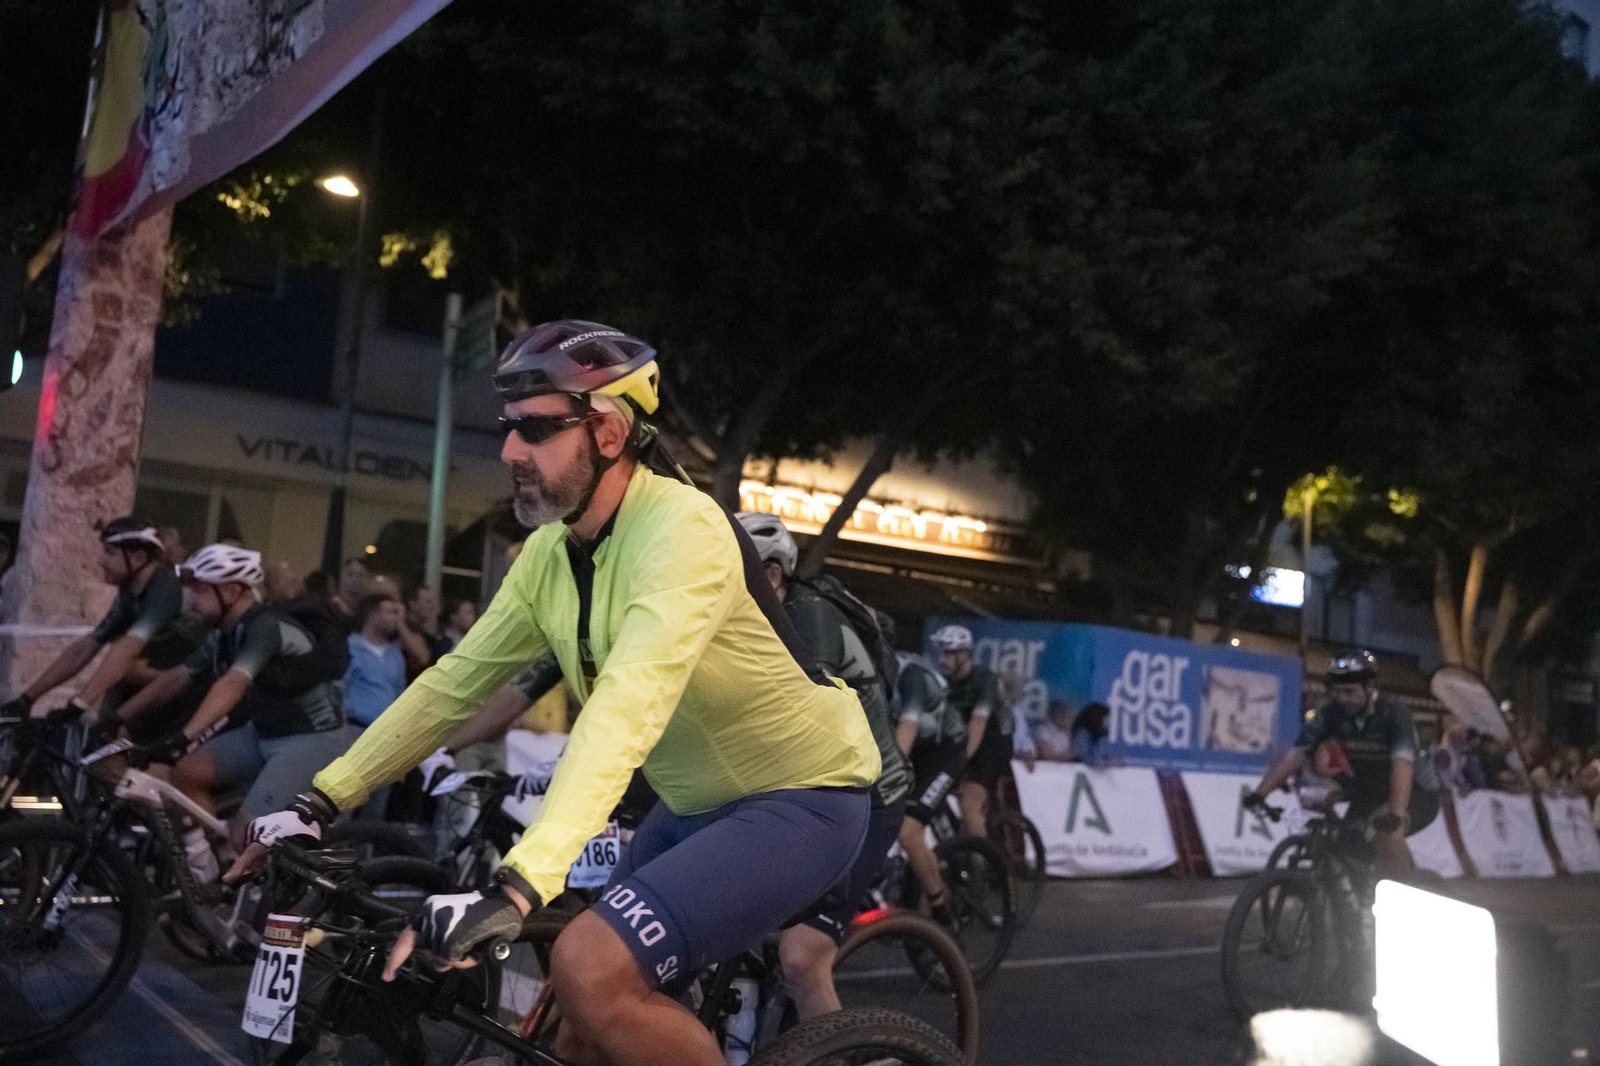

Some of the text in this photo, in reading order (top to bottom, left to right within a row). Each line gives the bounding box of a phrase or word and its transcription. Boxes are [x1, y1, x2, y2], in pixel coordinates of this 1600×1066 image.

[558, 329, 626, 351] ROCKRIDER
[236, 433, 458, 482] VITALDEN
[1122, 649, 1192, 714] gar
[1106, 677, 1193, 750] fusa
